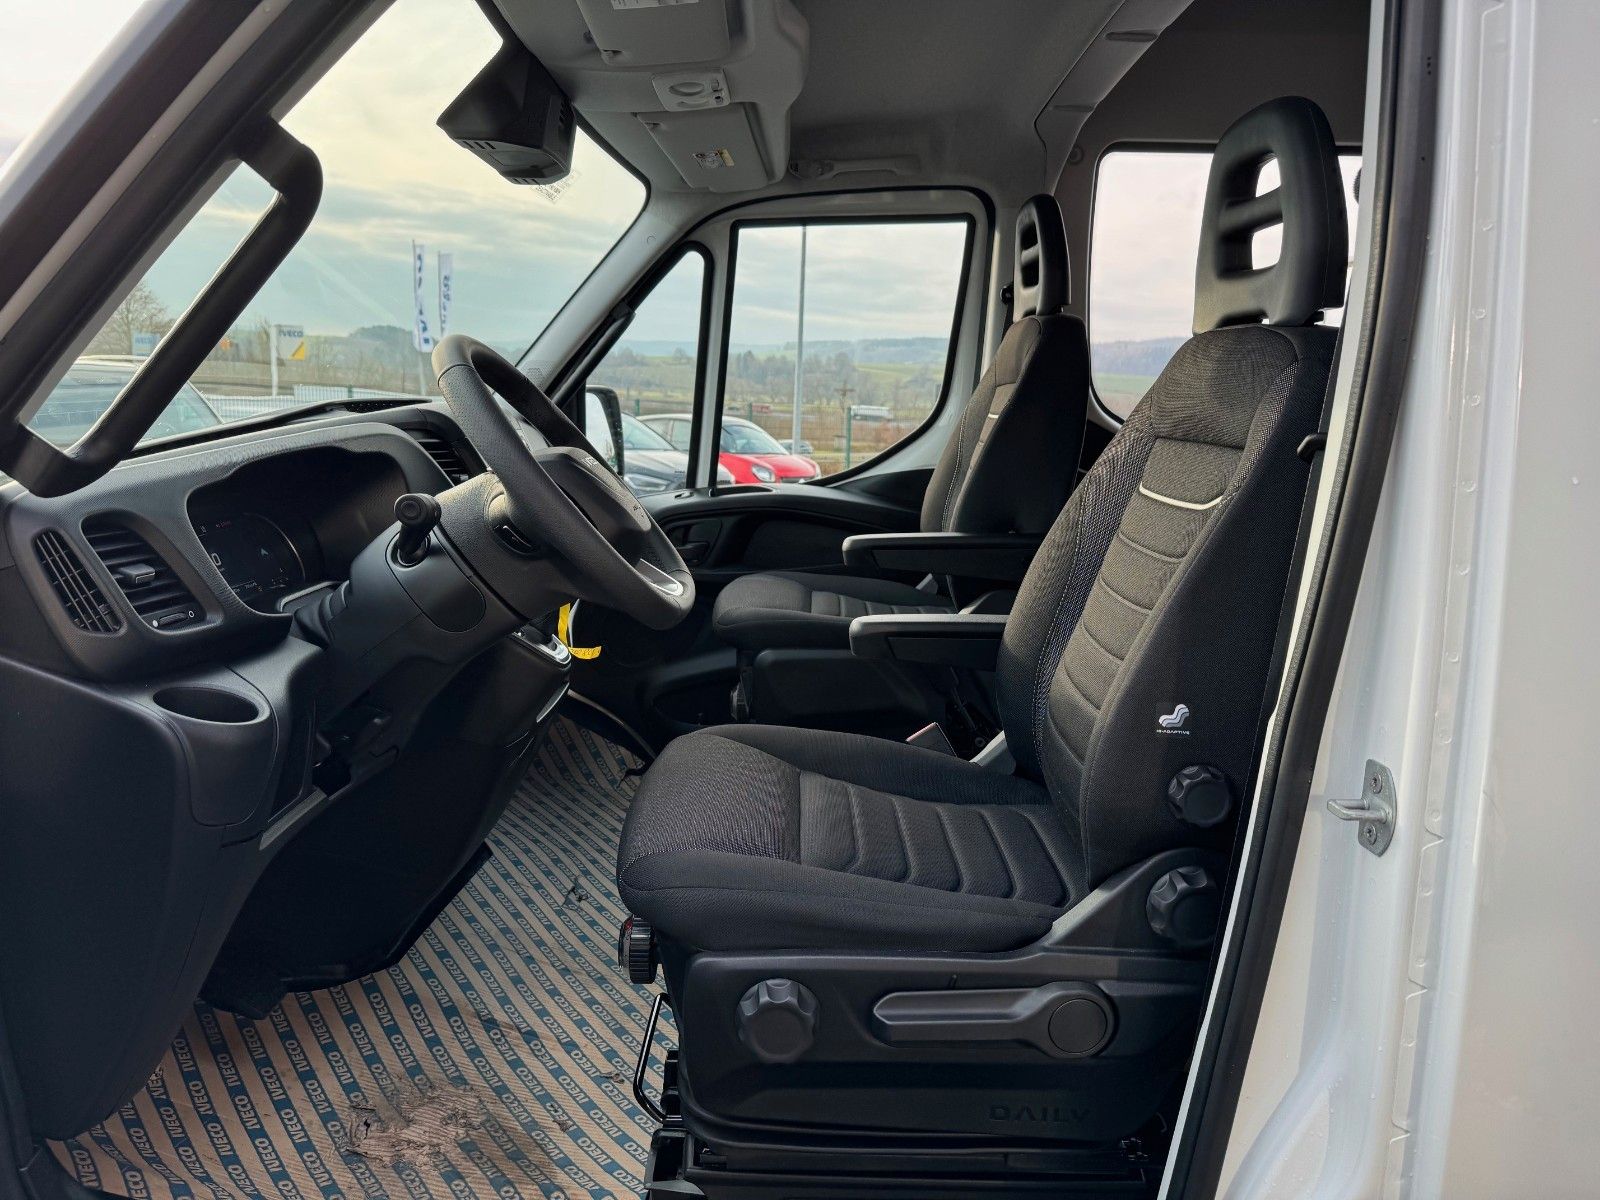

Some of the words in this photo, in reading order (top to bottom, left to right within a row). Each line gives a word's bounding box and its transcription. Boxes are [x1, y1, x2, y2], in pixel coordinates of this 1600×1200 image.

[484, 906, 506, 928] IVECO
[528, 903, 550, 924] IVECO
[560, 916, 582, 937] IVECO
[472, 923, 494, 944] IVECO
[518, 918, 540, 940] IVECO
[551, 931, 574, 951] IVECO
[458, 939, 480, 963] IVECO
[506, 933, 530, 957] IVECO
[541, 946, 564, 968] IVECO
[585, 942, 608, 963] IVECO
[444, 959, 466, 983] IVECO
[494, 951, 516, 976] IVECO
[530, 964, 552, 988] IVECO
[576, 957, 599, 978] IVECO
[388, 967, 412, 996] IVECO
[428, 978, 448, 1007] IVECO
[481, 970, 502, 995] IVECO
[565, 975, 593, 999] IVECO
[602, 983, 631, 1007] IVECO
[371, 993, 393, 1026] IVECO
[468, 991, 490, 1020] IVECO
[518, 984, 542, 1009] IVECO
[554, 996, 581, 1020] IVECO
[309, 1012, 331, 1043] IVECO
[409, 1004, 434, 1037] IVECO
[504, 1005, 531, 1032] IVECO
[543, 1017, 571, 1042] IVECO
[592, 1005, 620, 1029] IVECO
[243, 1027, 266, 1058] IVECO
[350, 1023, 373, 1056] IVECO
[450, 1017, 474, 1049] IVECO
[490, 1029, 516, 1060] IVECO
[582, 1027, 611, 1052] IVECO
[175, 1039, 195, 1071] IVECO
[286, 1040, 309, 1071] IVECO
[391, 1035, 416, 1067] IVECO
[433, 1046, 459, 1078] IVECO
[531, 1041, 557, 1069] IVECO
[571, 1051, 599, 1077] IVECO
[217, 1053, 241, 1087] IVECO
[329, 1052, 353, 1084] IVECO
[475, 1058, 501, 1088] IVECO
[518, 1067, 545, 1095] IVECO
[150, 1078, 166, 1099] IVE
[189, 1081, 213, 1114] IVECO
[262, 1067, 286, 1100] IVECO
[306, 1080, 331, 1112] IVECO
[559, 1075, 588, 1103] IVECO
[602, 1083, 632, 1110] IVECO
[160, 1107, 185, 1137] IVECO
[235, 1096, 260, 1129] IVECO
[502, 1094, 531, 1123] IVECO
[988, 1104, 1091, 1122] DAILY
[281, 1109, 307, 1143] IVECO
[590, 1109, 621, 1137] IVECO
[130, 1127, 154, 1157] IVECO
[206, 1123, 233, 1155] IVECO
[532, 1131, 563, 1159] IVECO
[578, 1137, 610, 1167] IVECO
[180, 1147, 206, 1177] IVECO
[255, 1138, 282, 1172] IVECO
[304, 1152, 332, 1186] IVECO
[124, 1171, 148, 1200] ECO
[228, 1165, 256, 1194] IVECO
[517, 1159, 549, 1184] IVECO
[564, 1166, 598, 1190] IVECO
[278, 1181, 302, 1200] ECO
